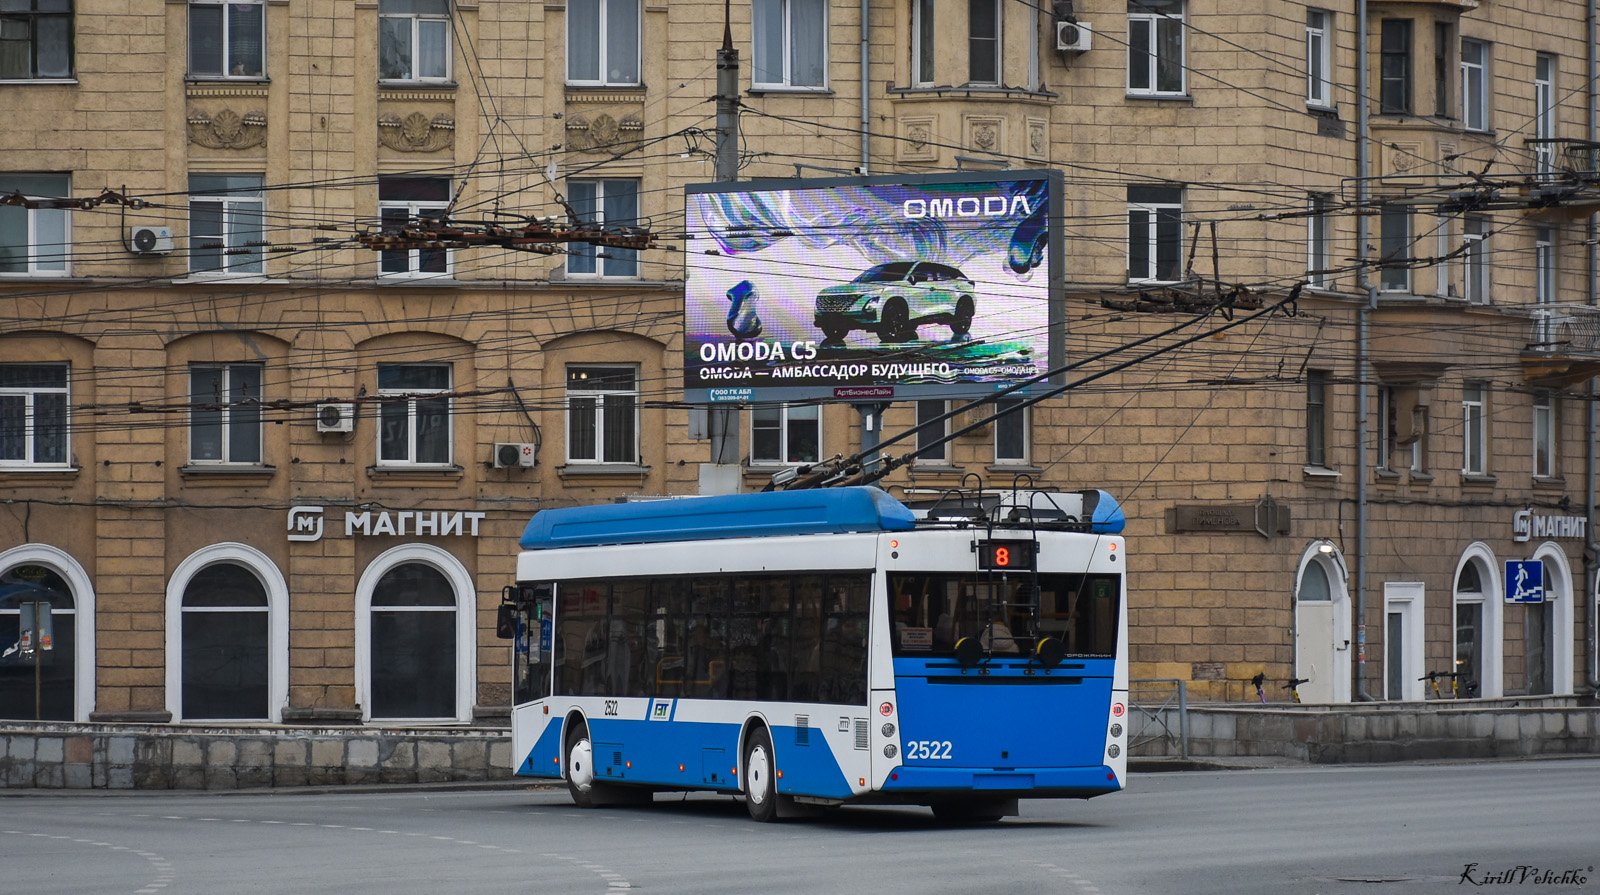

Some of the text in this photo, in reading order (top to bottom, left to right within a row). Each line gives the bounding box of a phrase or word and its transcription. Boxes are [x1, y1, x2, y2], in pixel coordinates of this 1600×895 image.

[903, 195, 1031, 218] OMODA
[700, 340, 817, 361] OMODA C5
[772, 364, 868, 380] АМБАССАДОР
[871, 362, 950, 379] БУДУЩЕГО
[345, 511, 486, 536] МАГНИТ
[1532, 515, 1588, 538] МАГНИТ
[996, 547, 1009, 566] 8
[604, 700, 618, 716] 2522
[907, 740, 953, 759] 2522
